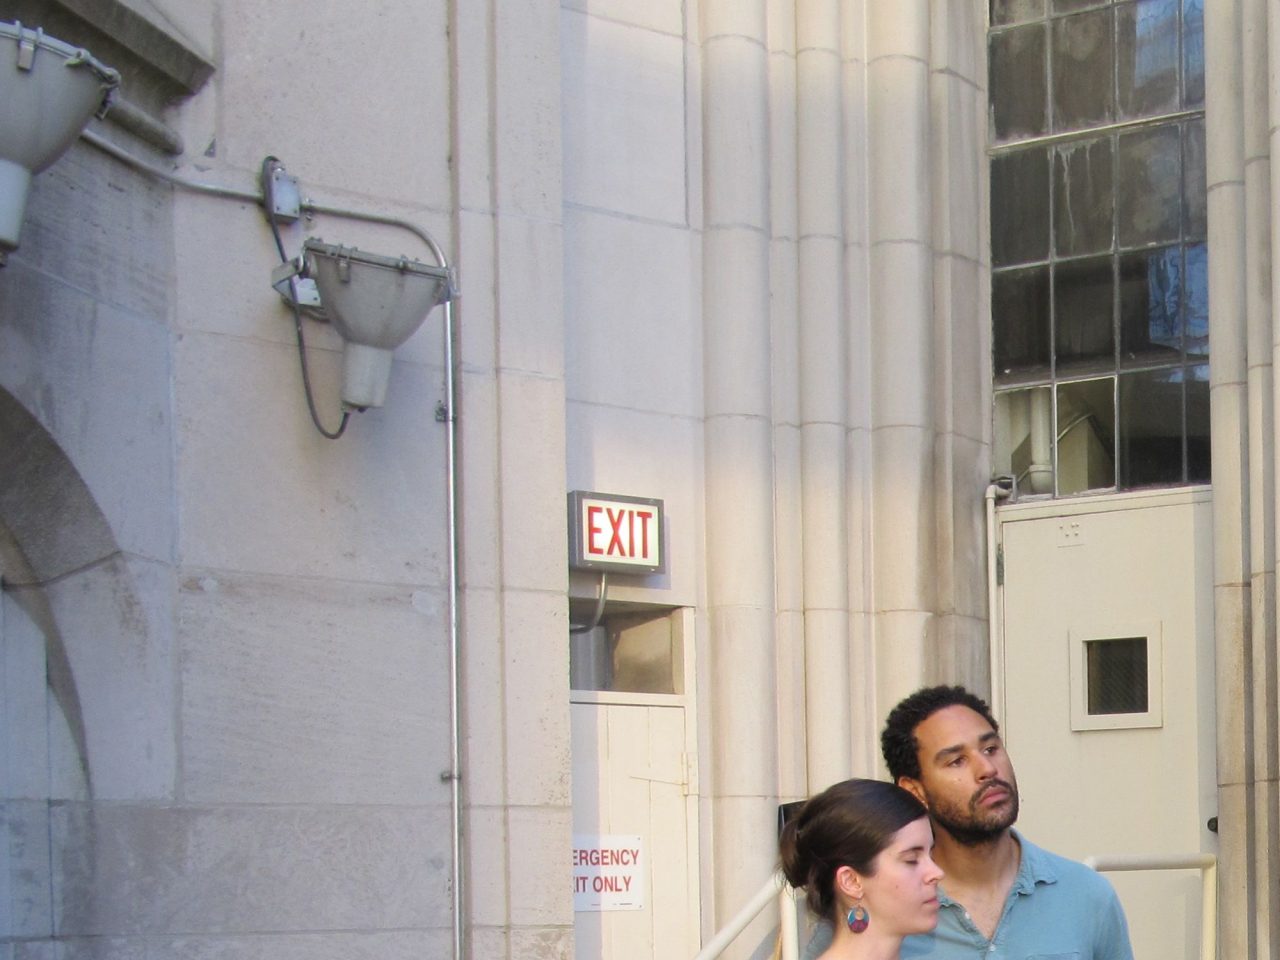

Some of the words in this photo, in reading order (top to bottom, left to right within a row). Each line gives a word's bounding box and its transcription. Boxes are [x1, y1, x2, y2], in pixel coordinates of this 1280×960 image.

[587, 506, 653, 559] EXIT
[573, 849, 639, 866] ERGENCY
[574, 876, 588, 893] IT
[592, 876, 632, 893] ONLY
